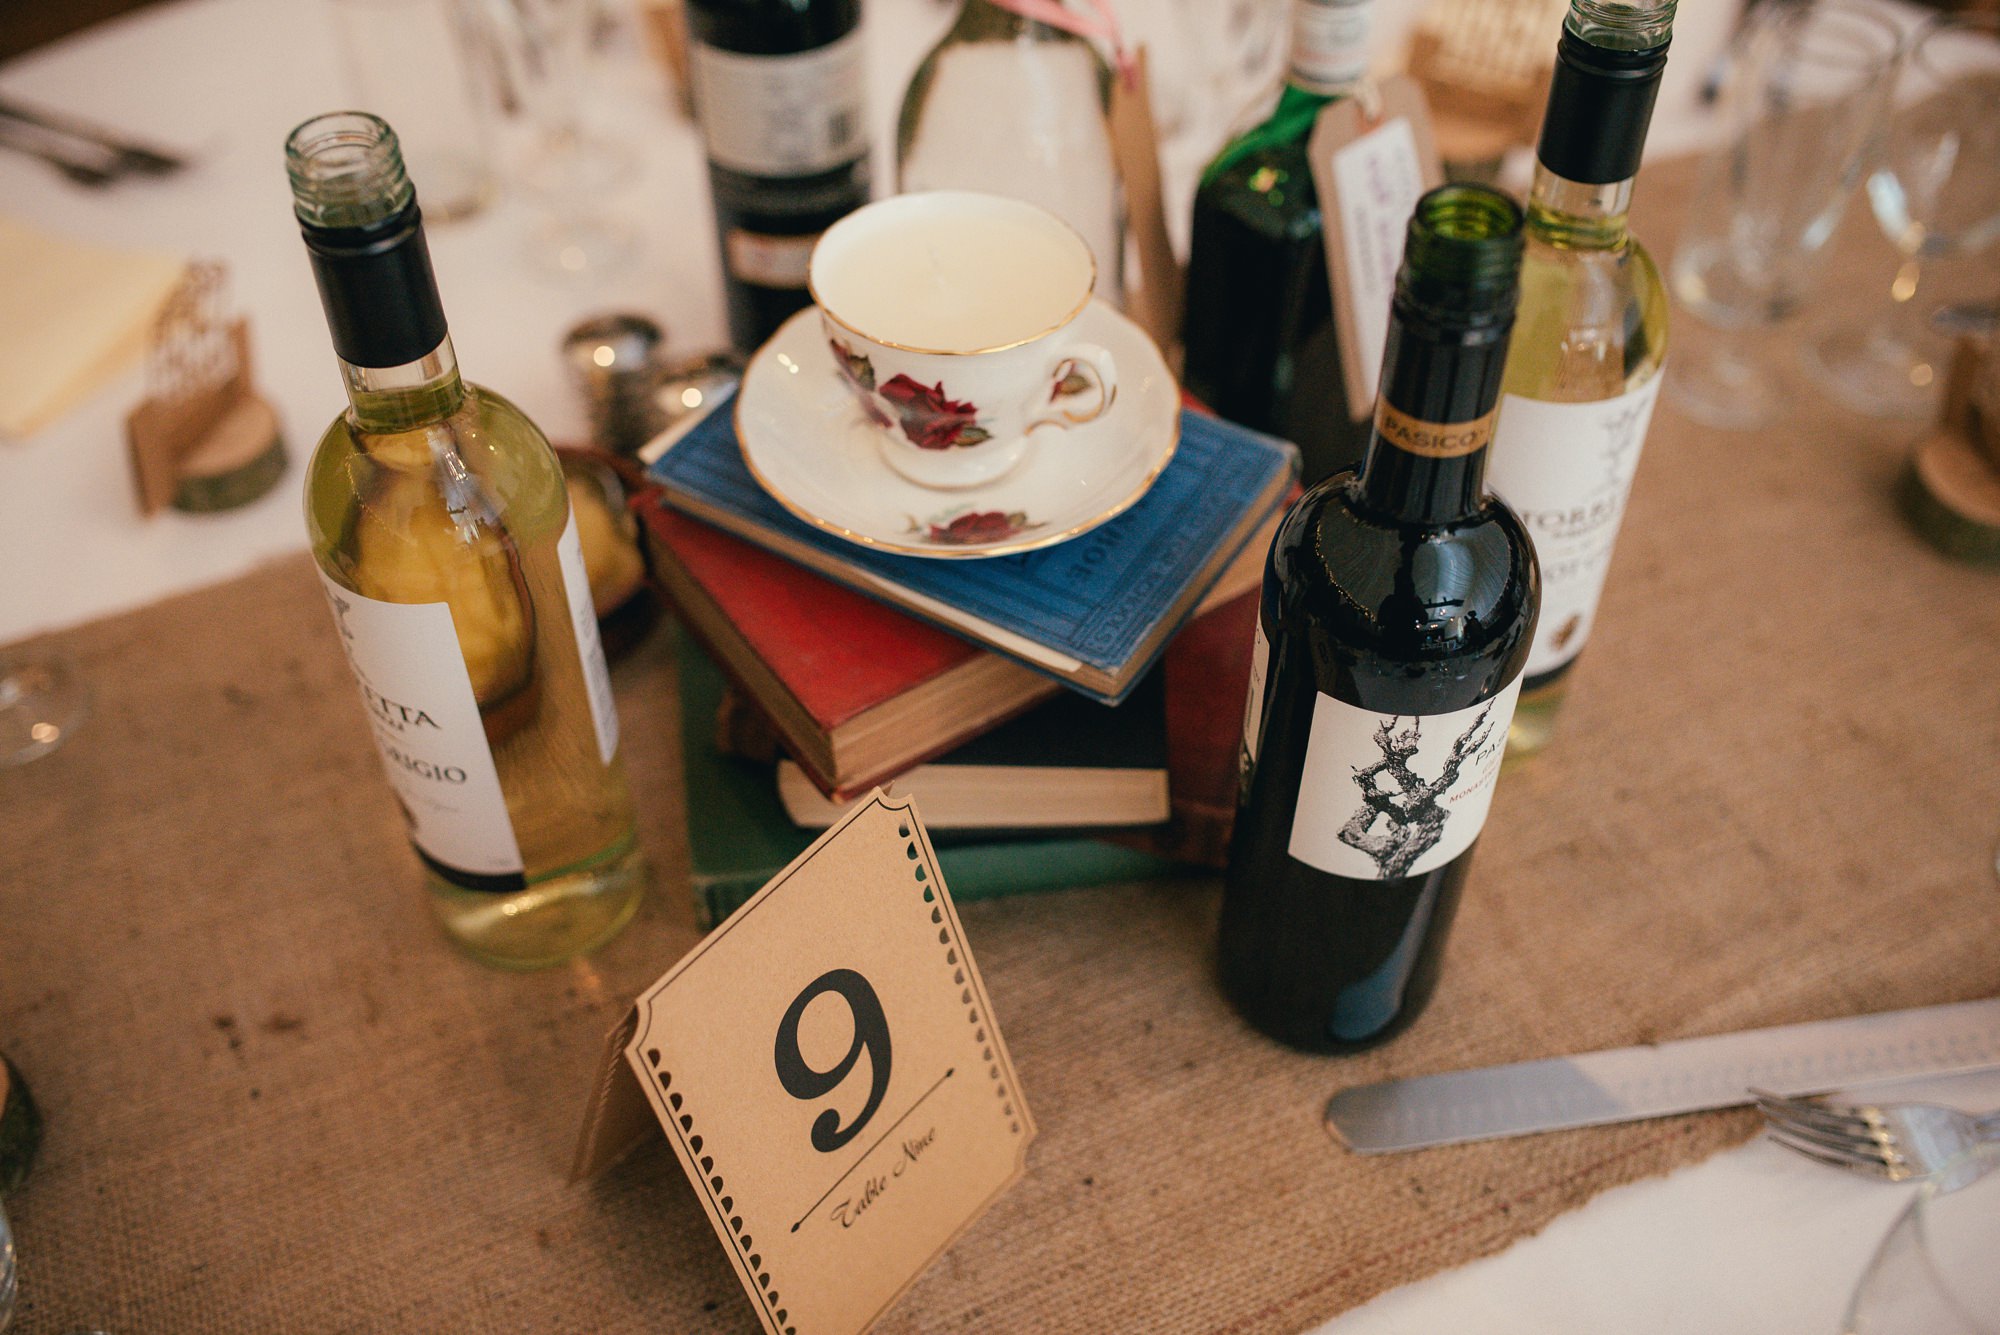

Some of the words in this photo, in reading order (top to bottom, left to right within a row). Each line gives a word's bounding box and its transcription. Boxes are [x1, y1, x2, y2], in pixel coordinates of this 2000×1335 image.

[1384, 415, 1478, 449] PASICO
[774, 968, 892, 1153] 9
[830, 1176, 887, 1228] Table
[893, 1127, 936, 1177] Nine
